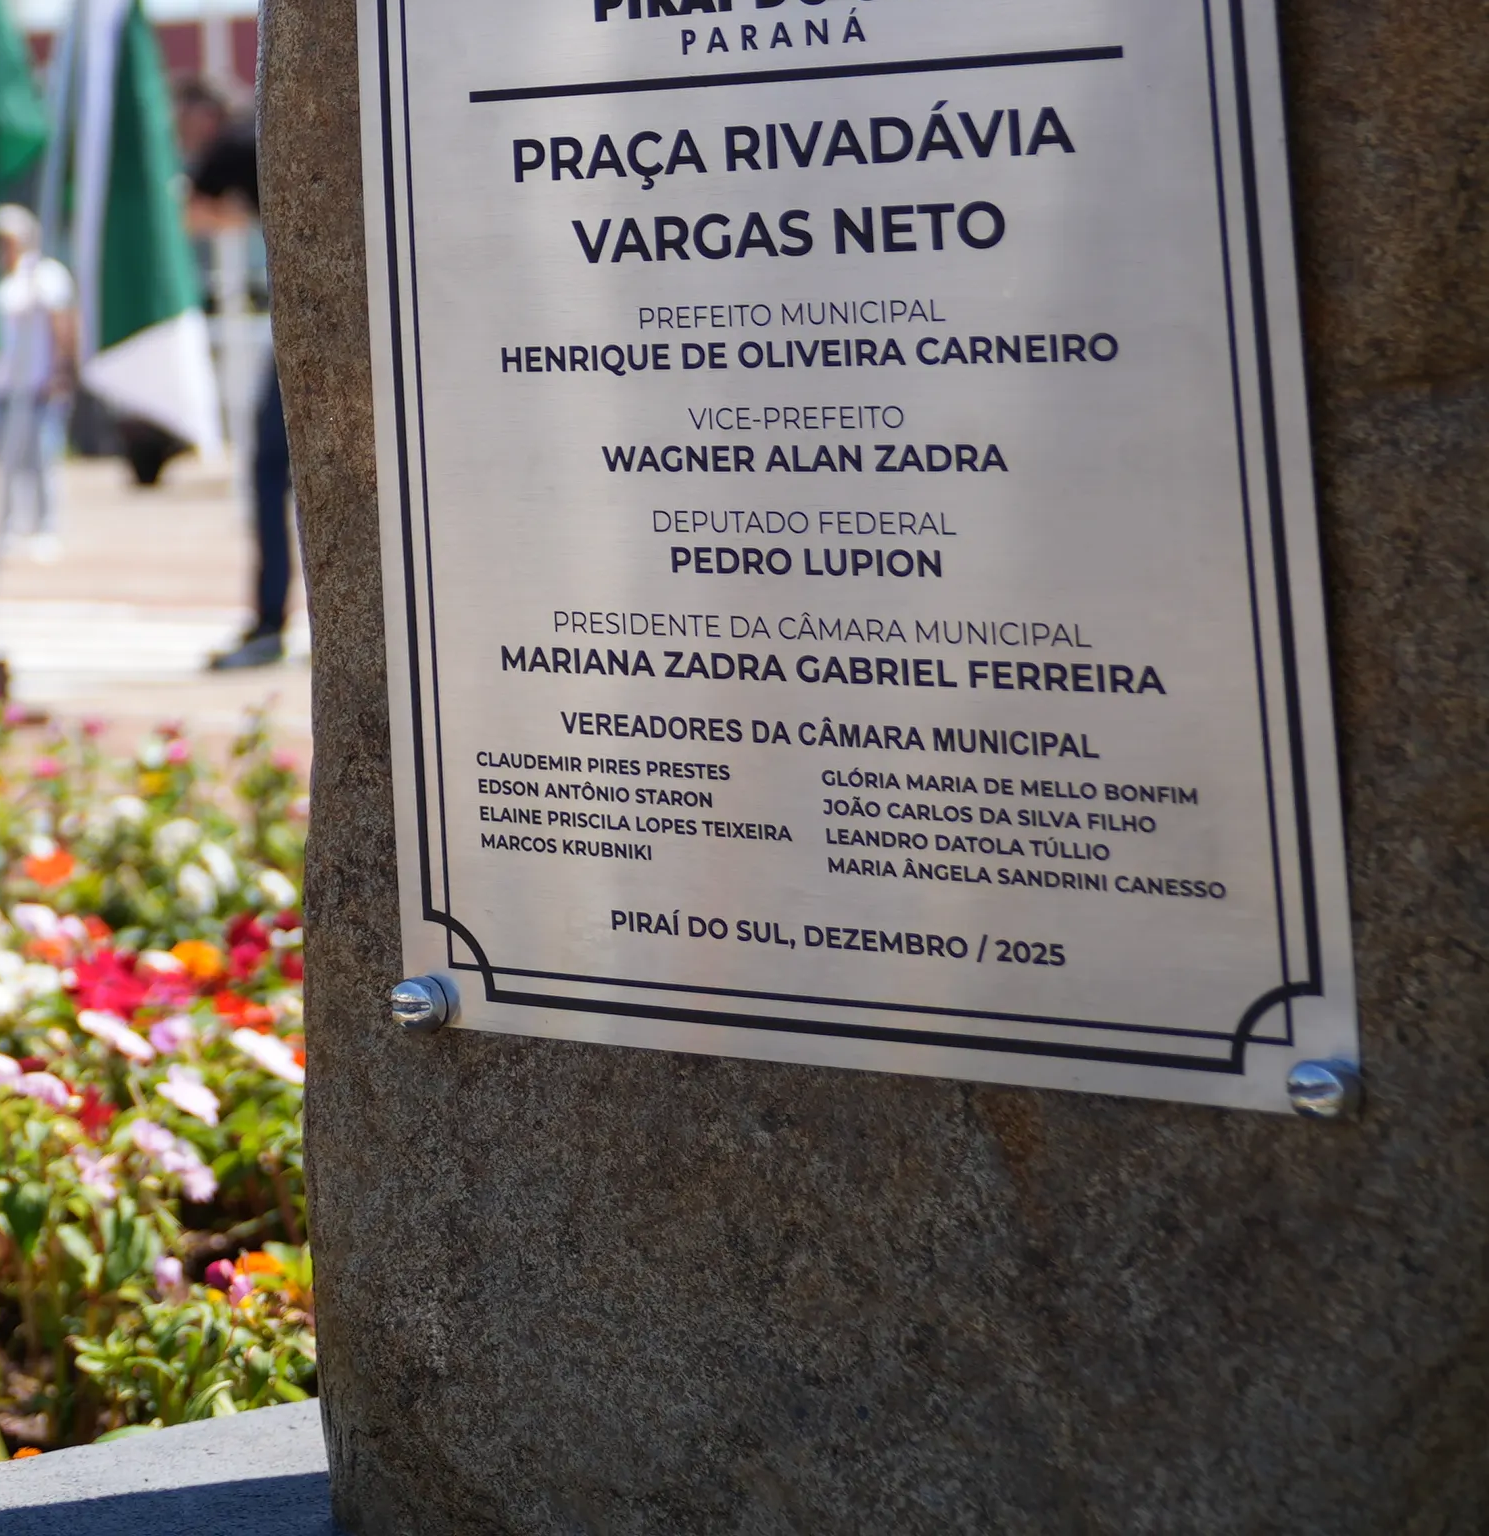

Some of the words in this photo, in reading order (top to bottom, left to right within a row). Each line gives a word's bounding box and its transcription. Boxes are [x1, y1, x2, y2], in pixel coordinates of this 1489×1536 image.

[681, 7, 866, 55] PARANÁ
[513, 129, 707, 190] PRAÇA
[725, 100, 1076, 171] RIVADÁVIA
[571, 209, 813, 263] VARGAS
[833, 201, 1005, 254] NETO
[639, 304, 771, 329] PREFEITO
[782, 299, 946, 325] MUNICIPAL
[501, 344, 671, 376] HENRIQUE
[682, 342, 727, 369] DE
[738, 338, 906, 368] OLIVEIRA
[916, 333, 1118, 365] CARNEIRO
[688, 406, 904, 430] VICE-PREFEITO
[602, 445, 755, 472] WAGNER
[765, 445, 862, 472] ALAN
[874, 444, 1009, 472] ZADRA
[653, 510, 808, 534] DEPUTADO
[819, 512, 956, 535] FEDERAL
[671, 547, 792, 575] PEDRO
[804, 548, 942, 577] LUPION
[554, 611, 721, 637] PRESIDENTE
[731, 616, 771, 639] DA
[778, 612, 907, 642] CÂMARA
[915, 620, 1092, 648] MUNICIPAL
[501, 645, 655, 677] MARIANA
[664, 651, 787, 682] ZADRA
[796, 655, 957, 687] GABRIEL
[969, 660, 1167, 694] FERREIRA
[561, 711, 743, 742] VEREADORES
[752, 720, 791, 745] DA
[798, 717, 925, 751] CÂMARA
[933, 728, 1100, 759] MUNICIPAL
[477, 751, 582, 772] CLAUDEMIR
[588, 758, 641, 775] PIRES
[646, 761, 730, 780] PRESTES
[478, 779, 539, 797] EDSON
[545, 781, 630, 803] ANTÔNIO
[635, 788, 712, 808] STARON
[822, 767, 901, 789] GLÓRIA
[906, 774, 978, 793] MARIA
[984, 778, 1014, 795] DE
[1021, 780, 1097, 800] MELLO
[1105, 784, 1198, 805] BONFIM
[480, 806, 542, 825] ELAINE
[548, 811, 630, 831] PRISCILA
[636, 816, 697, 835] LOPES
[702, 820, 793, 842] TEIXEIRA
[823, 796, 881, 818] JOÃO
[887, 802, 973, 823] CARLOS
[979, 807, 1012, 825] DA
[1017, 809, 1081, 829] SILVA
[1087, 813, 1156, 833] FILHO
[481, 833, 557, 853] MARCOS
[563, 839, 652, 860] KRUBNIKI
[826, 828, 928, 850] LEANDRO
[935, 835, 1025, 856] DATOLA
[1029, 837, 1110, 861] TÚLLIO
[828, 857, 897, 877] MARIA
[902, 858, 992, 884] ÂNGELA
[997, 868, 1107, 891] SANDRINI
[1115, 876, 1226, 899] CANESSO
[611, 910, 679, 936] PIRAÍ
[688, 916, 728, 939] DO
[736, 920, 795, 949] SUL,
[804, 925, 968, 958] DEZEMBRO
[977, 934, 988, 962] /
[995, 940, 1065, 966] 2025
